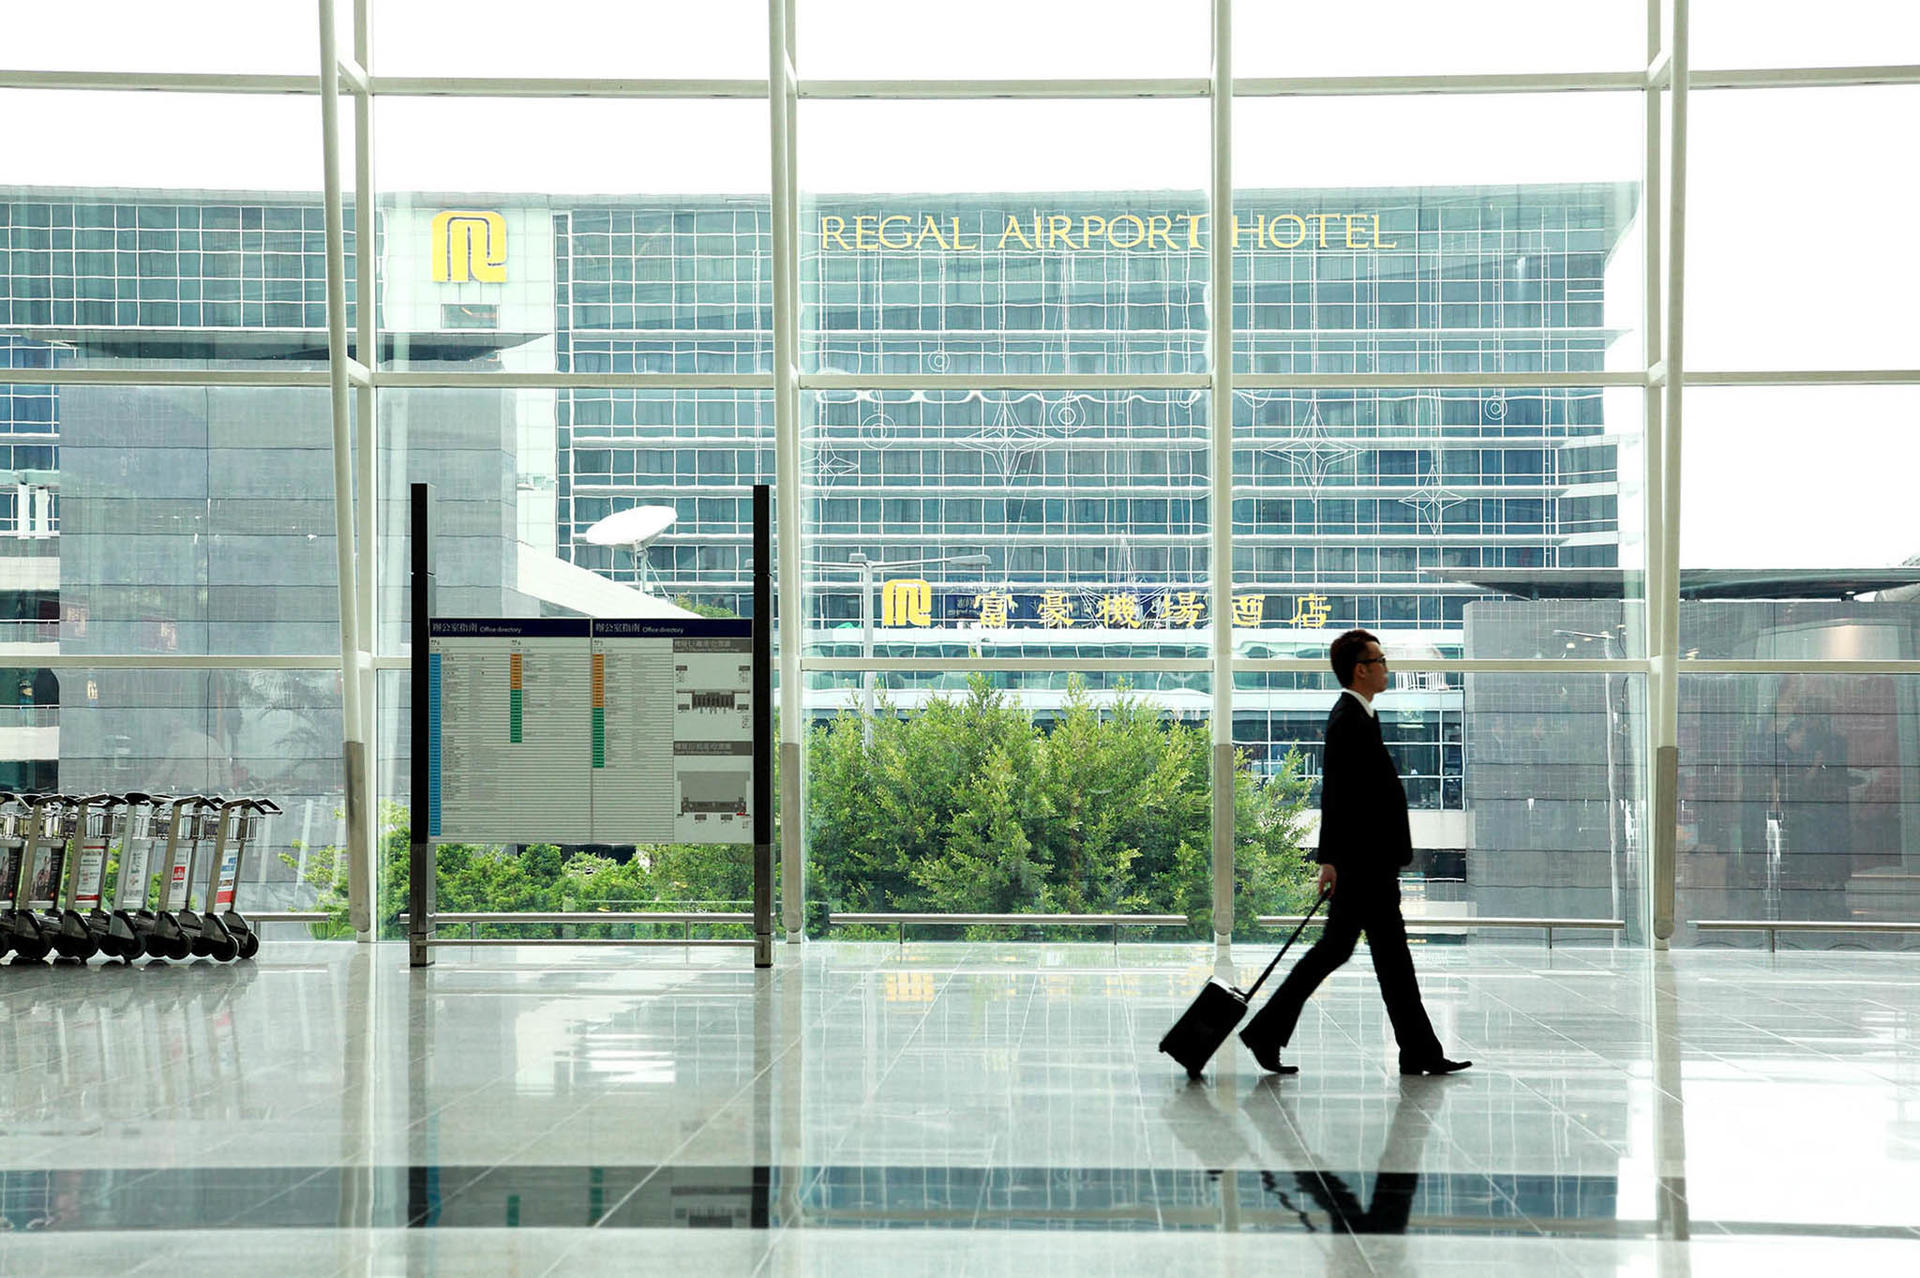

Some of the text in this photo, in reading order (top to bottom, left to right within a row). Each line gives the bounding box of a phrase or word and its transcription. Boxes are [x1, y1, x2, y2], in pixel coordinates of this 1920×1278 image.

[821, 213, 1397, 250] REGAL AIRPORT HOTEL
